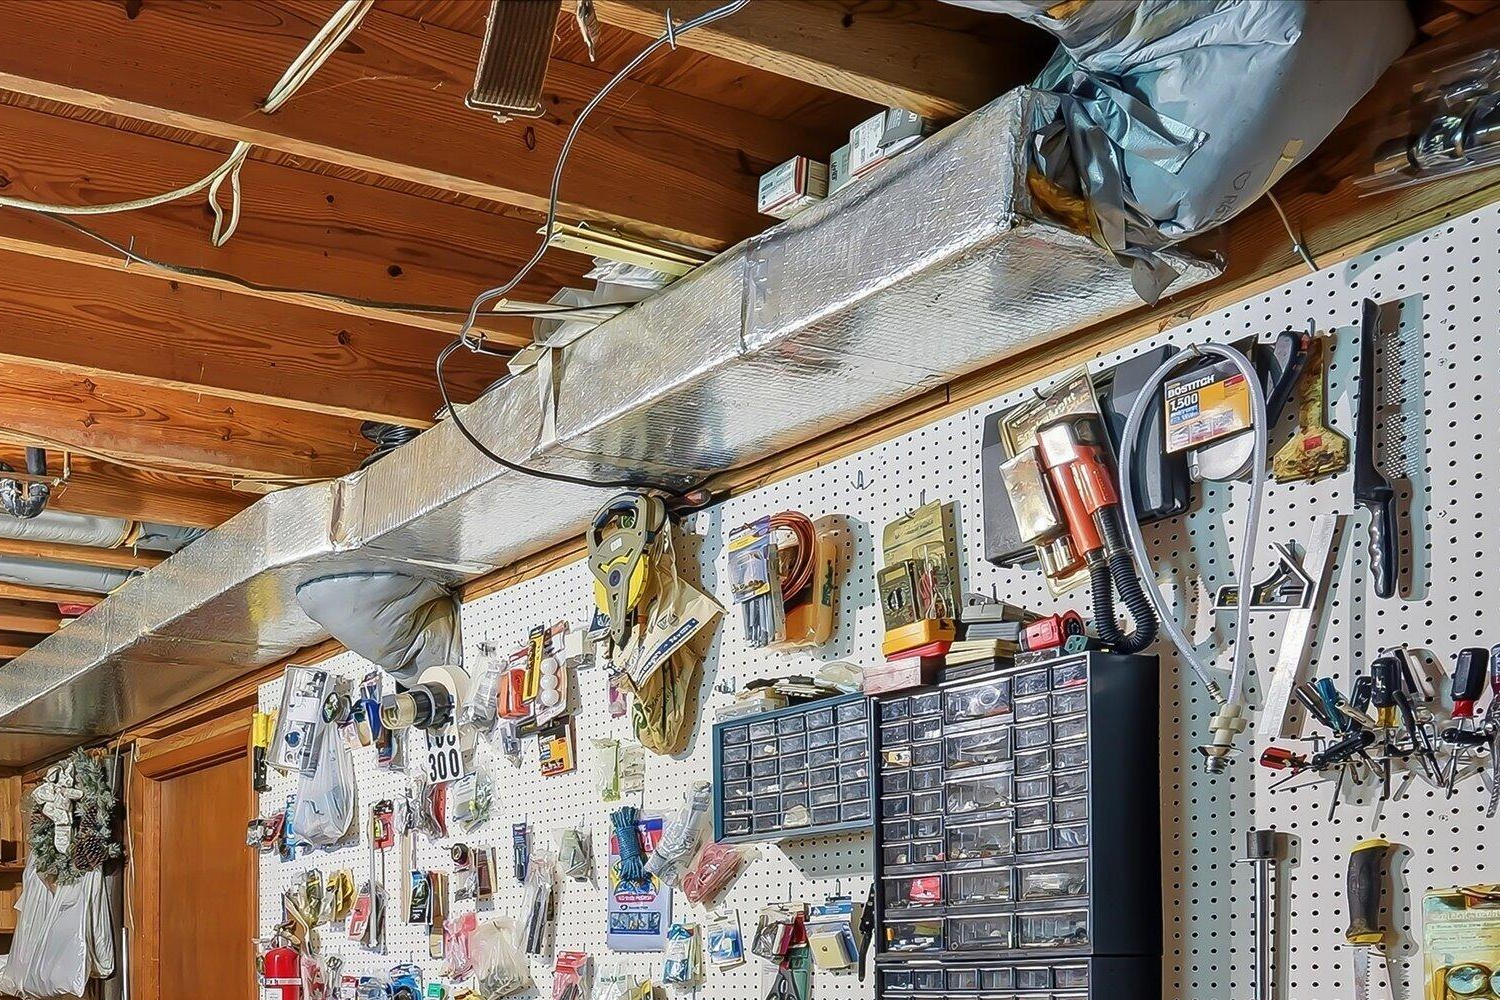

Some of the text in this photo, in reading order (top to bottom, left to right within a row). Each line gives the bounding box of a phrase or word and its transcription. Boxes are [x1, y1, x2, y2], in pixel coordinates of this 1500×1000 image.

[1168, 374, 1215, 398] BOSTITCH
[1169, 393, 1198, 412] 1,500
[428, 748, 460, 782] 300
